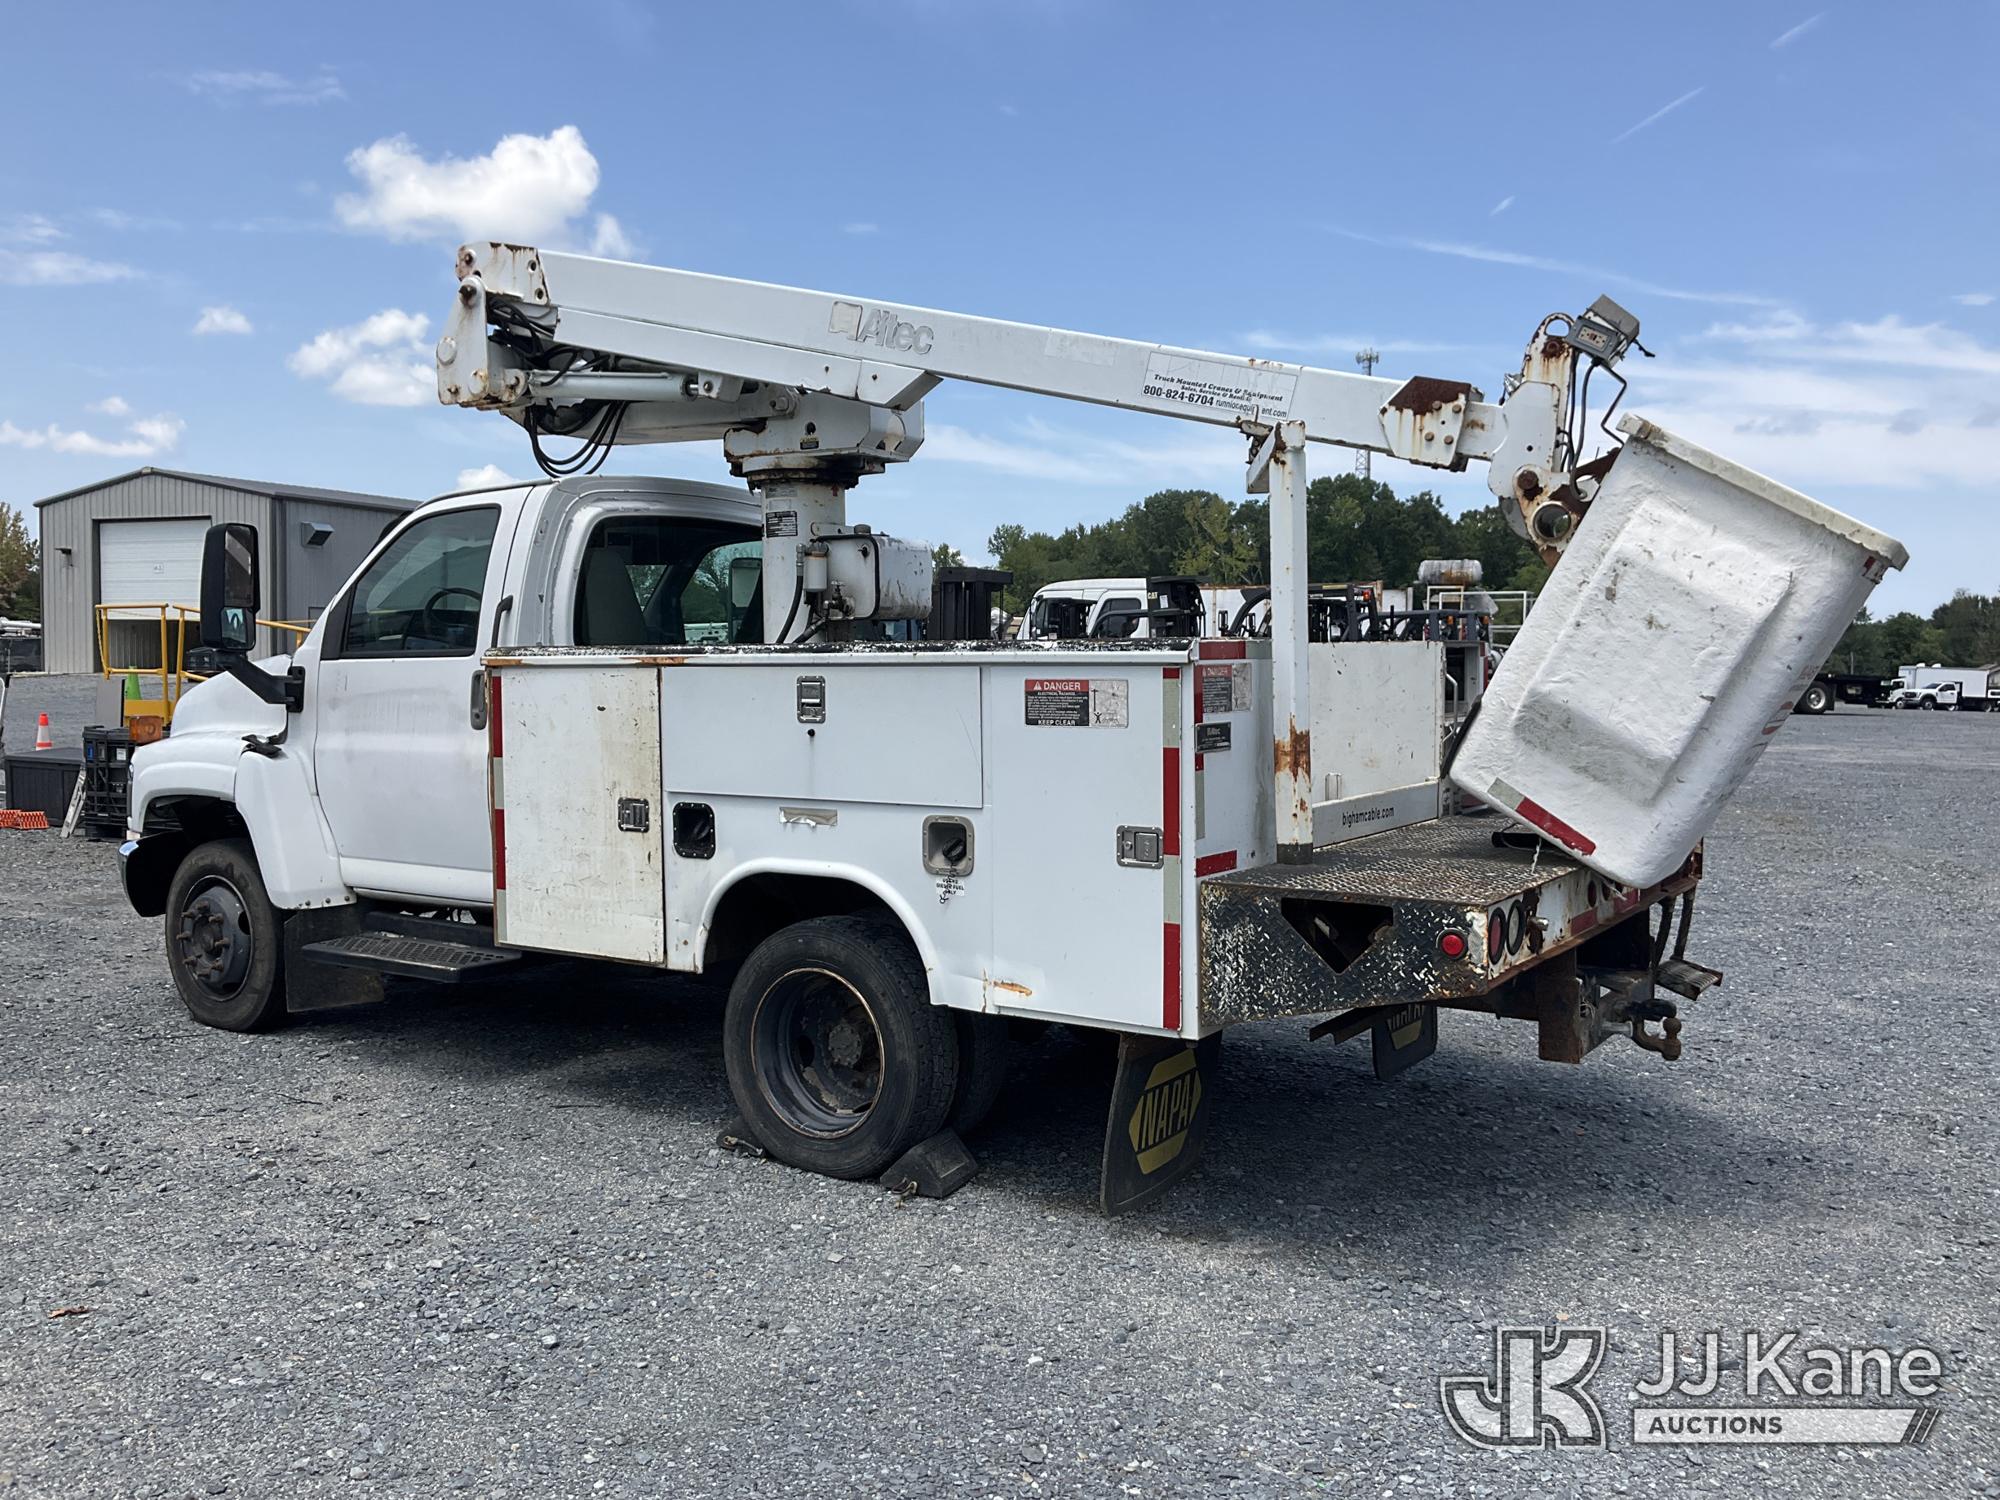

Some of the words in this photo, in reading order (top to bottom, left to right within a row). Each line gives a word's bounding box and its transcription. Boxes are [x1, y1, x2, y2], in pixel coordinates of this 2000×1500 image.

[858, 309, 934, 355] Altec
[1154, 374, 1175, 383] Truck
[1176, 378, 1207, 388] Mounted
[1208, 383, 1233, 393] Cranes
[1199, 388, 1221, 397] Service
[1143, 384, 1214, 406] 800-824-6704
[1043, 681, 1081, 690] DANGER
[1342, 807, 1395, 828] bighamcable.com
[1141, 1073, 1192, 1150] NAPA
